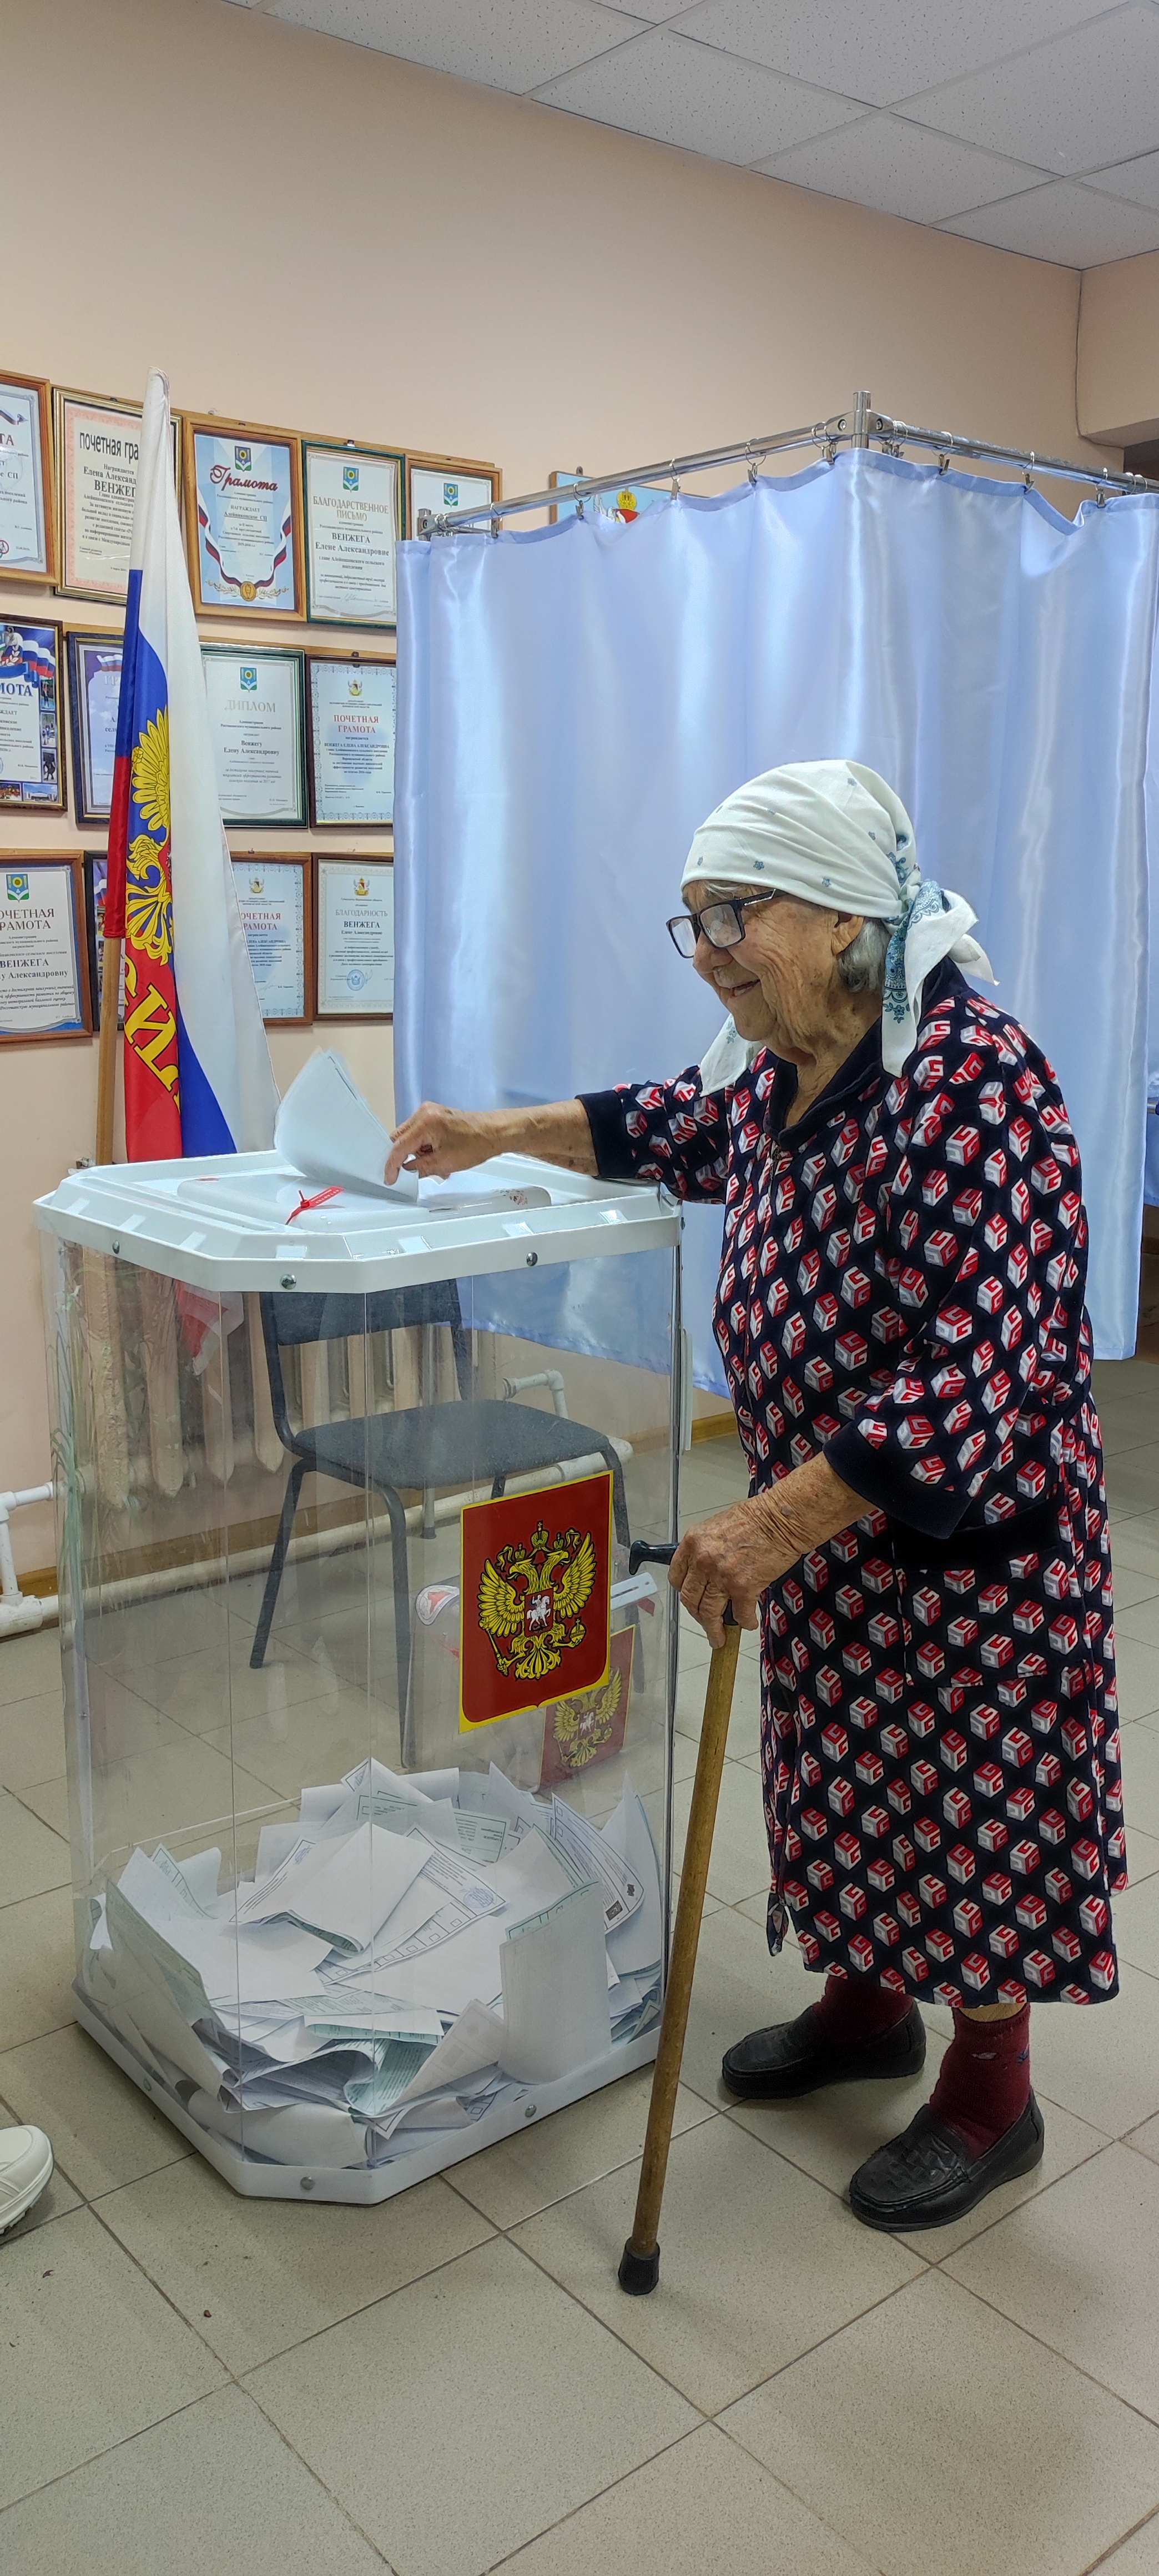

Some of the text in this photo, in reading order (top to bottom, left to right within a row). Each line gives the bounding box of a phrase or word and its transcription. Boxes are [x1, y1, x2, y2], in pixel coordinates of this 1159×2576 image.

[80, 432, 122, 457] почетная
[84, 466, 103, 477] Елена
[104, 464, 134, 475] Награждается
[210, 465, 278, 491] Грамота
[313, 496, 389, 514] БЛАГОДАРСТВЕННОЕ
[336, 510, 367, 521] ПИСЬМО
[332, 532, 371, 544] ВЕНЖЕГА
[315, 541, 389, 557] Елене Александровне
[224, 700, 276, 713] ДИПЛОМ
[334, 715, 379, 723] ПОЧЕТНАЯ
[337, 725, 376, 733] ГРАМОТА
[240, 748, 280, 756] Александровну
[0, 920, 51, 931] РАМОТА
[0, 958, 49, 969] ВЕНЖЕГА
[8, 970, 68, 979] Александровну
